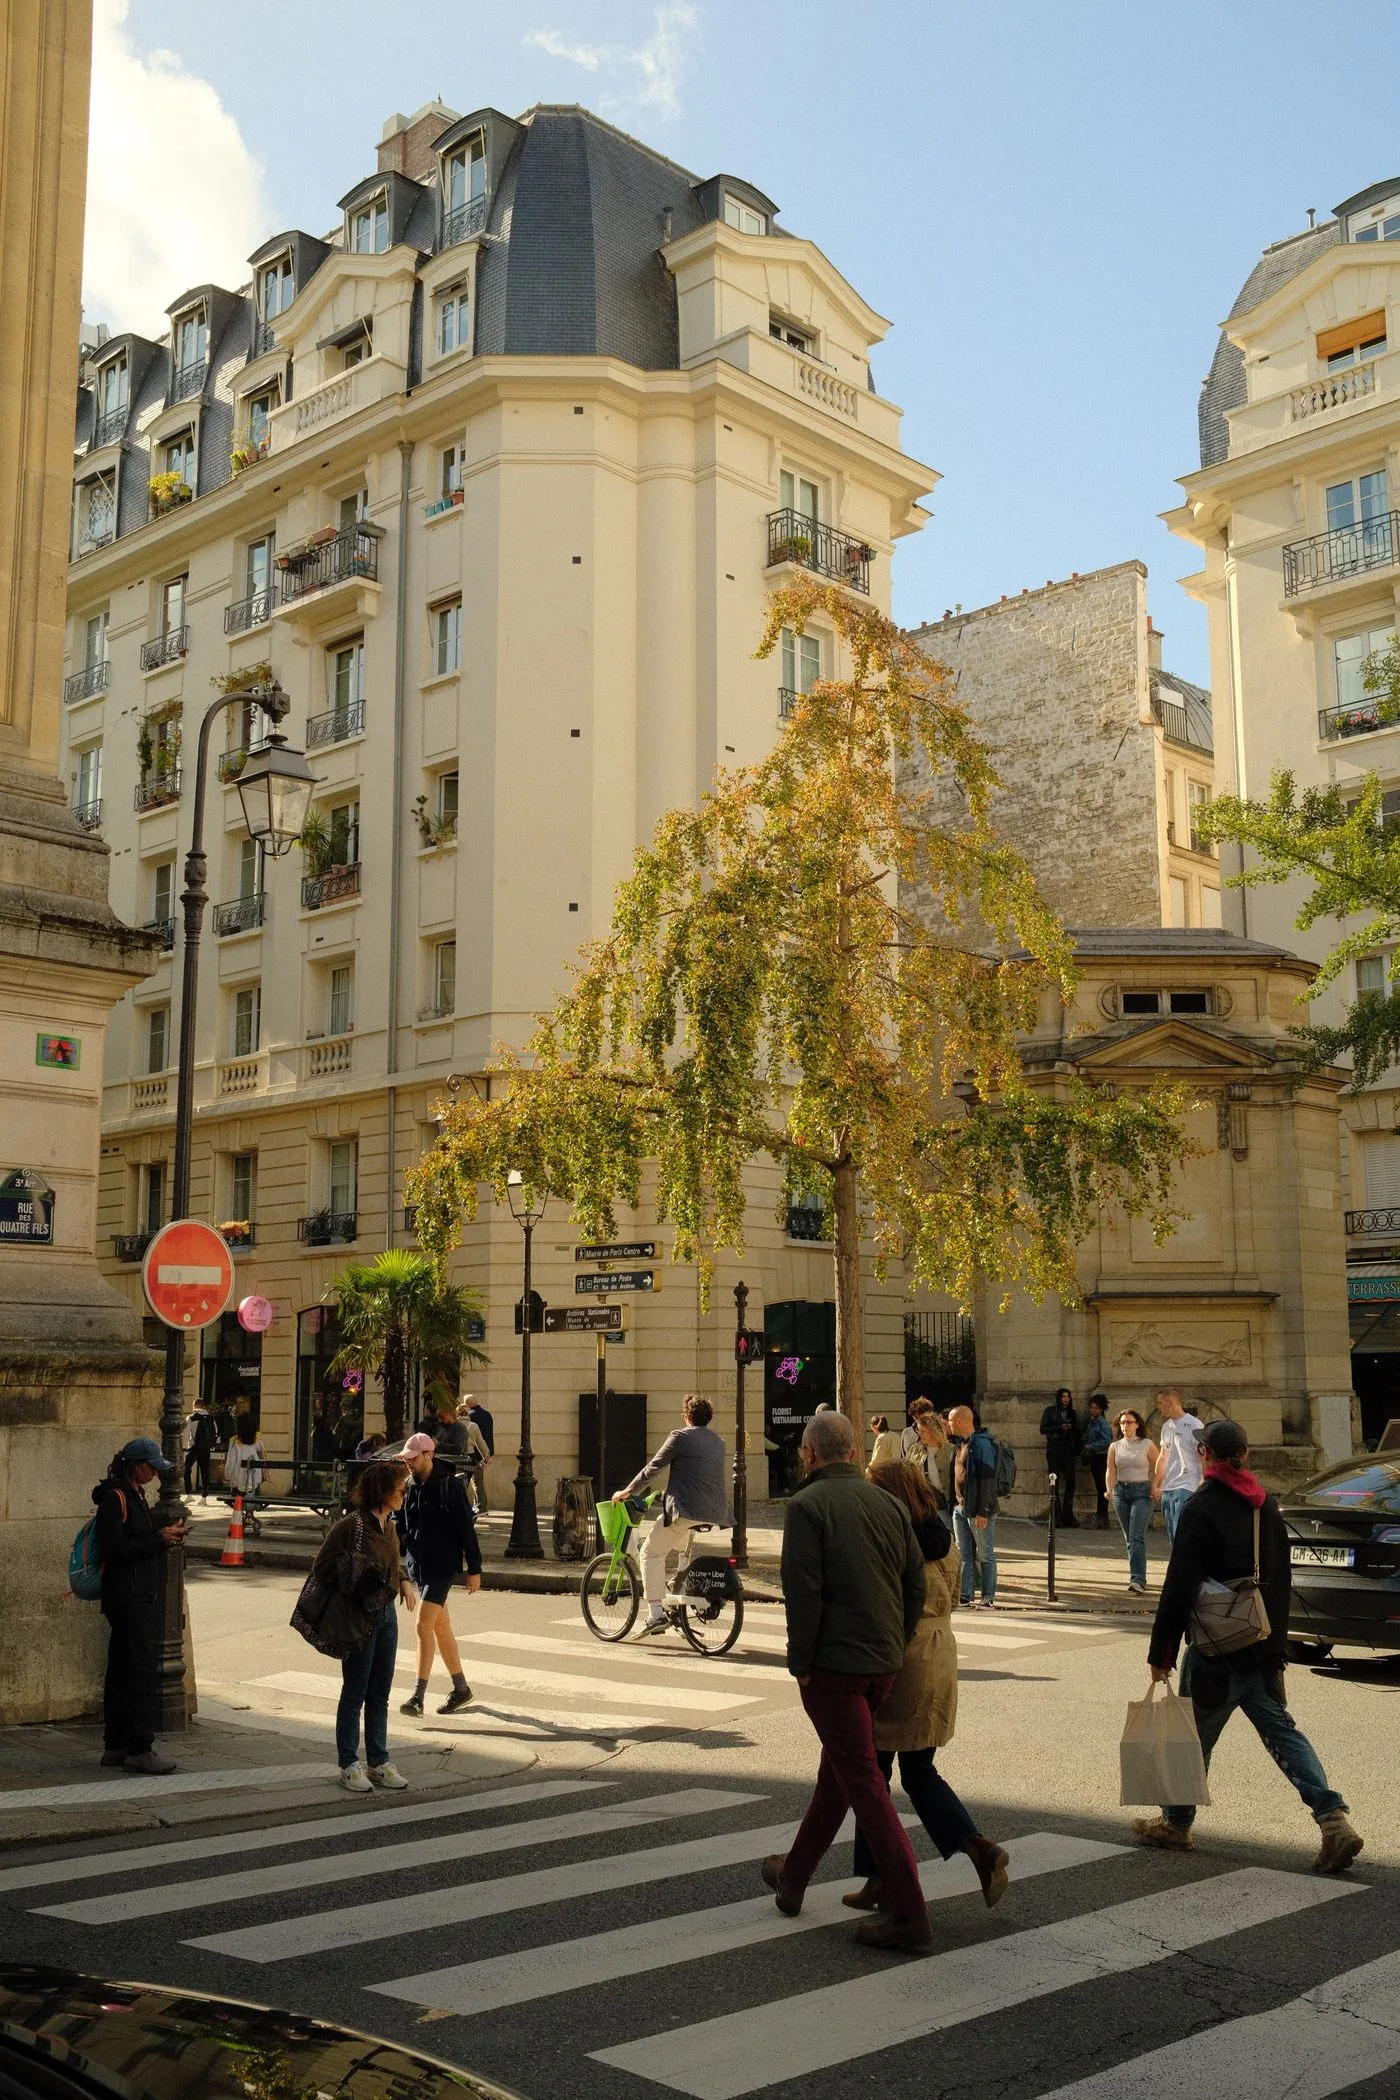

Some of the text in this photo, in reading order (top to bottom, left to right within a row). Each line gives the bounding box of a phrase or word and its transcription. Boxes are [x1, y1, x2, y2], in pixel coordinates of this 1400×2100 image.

[17, 1202, 33, 1214] RUE
[0, 1221, 49, 1235] QUATRE FILS
[586, 1247, 641, 1257] Mairie de Paris Centre
[593, 1276, 609, 1284] Bureau
[566, 1307, 610, 1317] Archives Nationales
[711, 1580, 726, 1588] Lime
